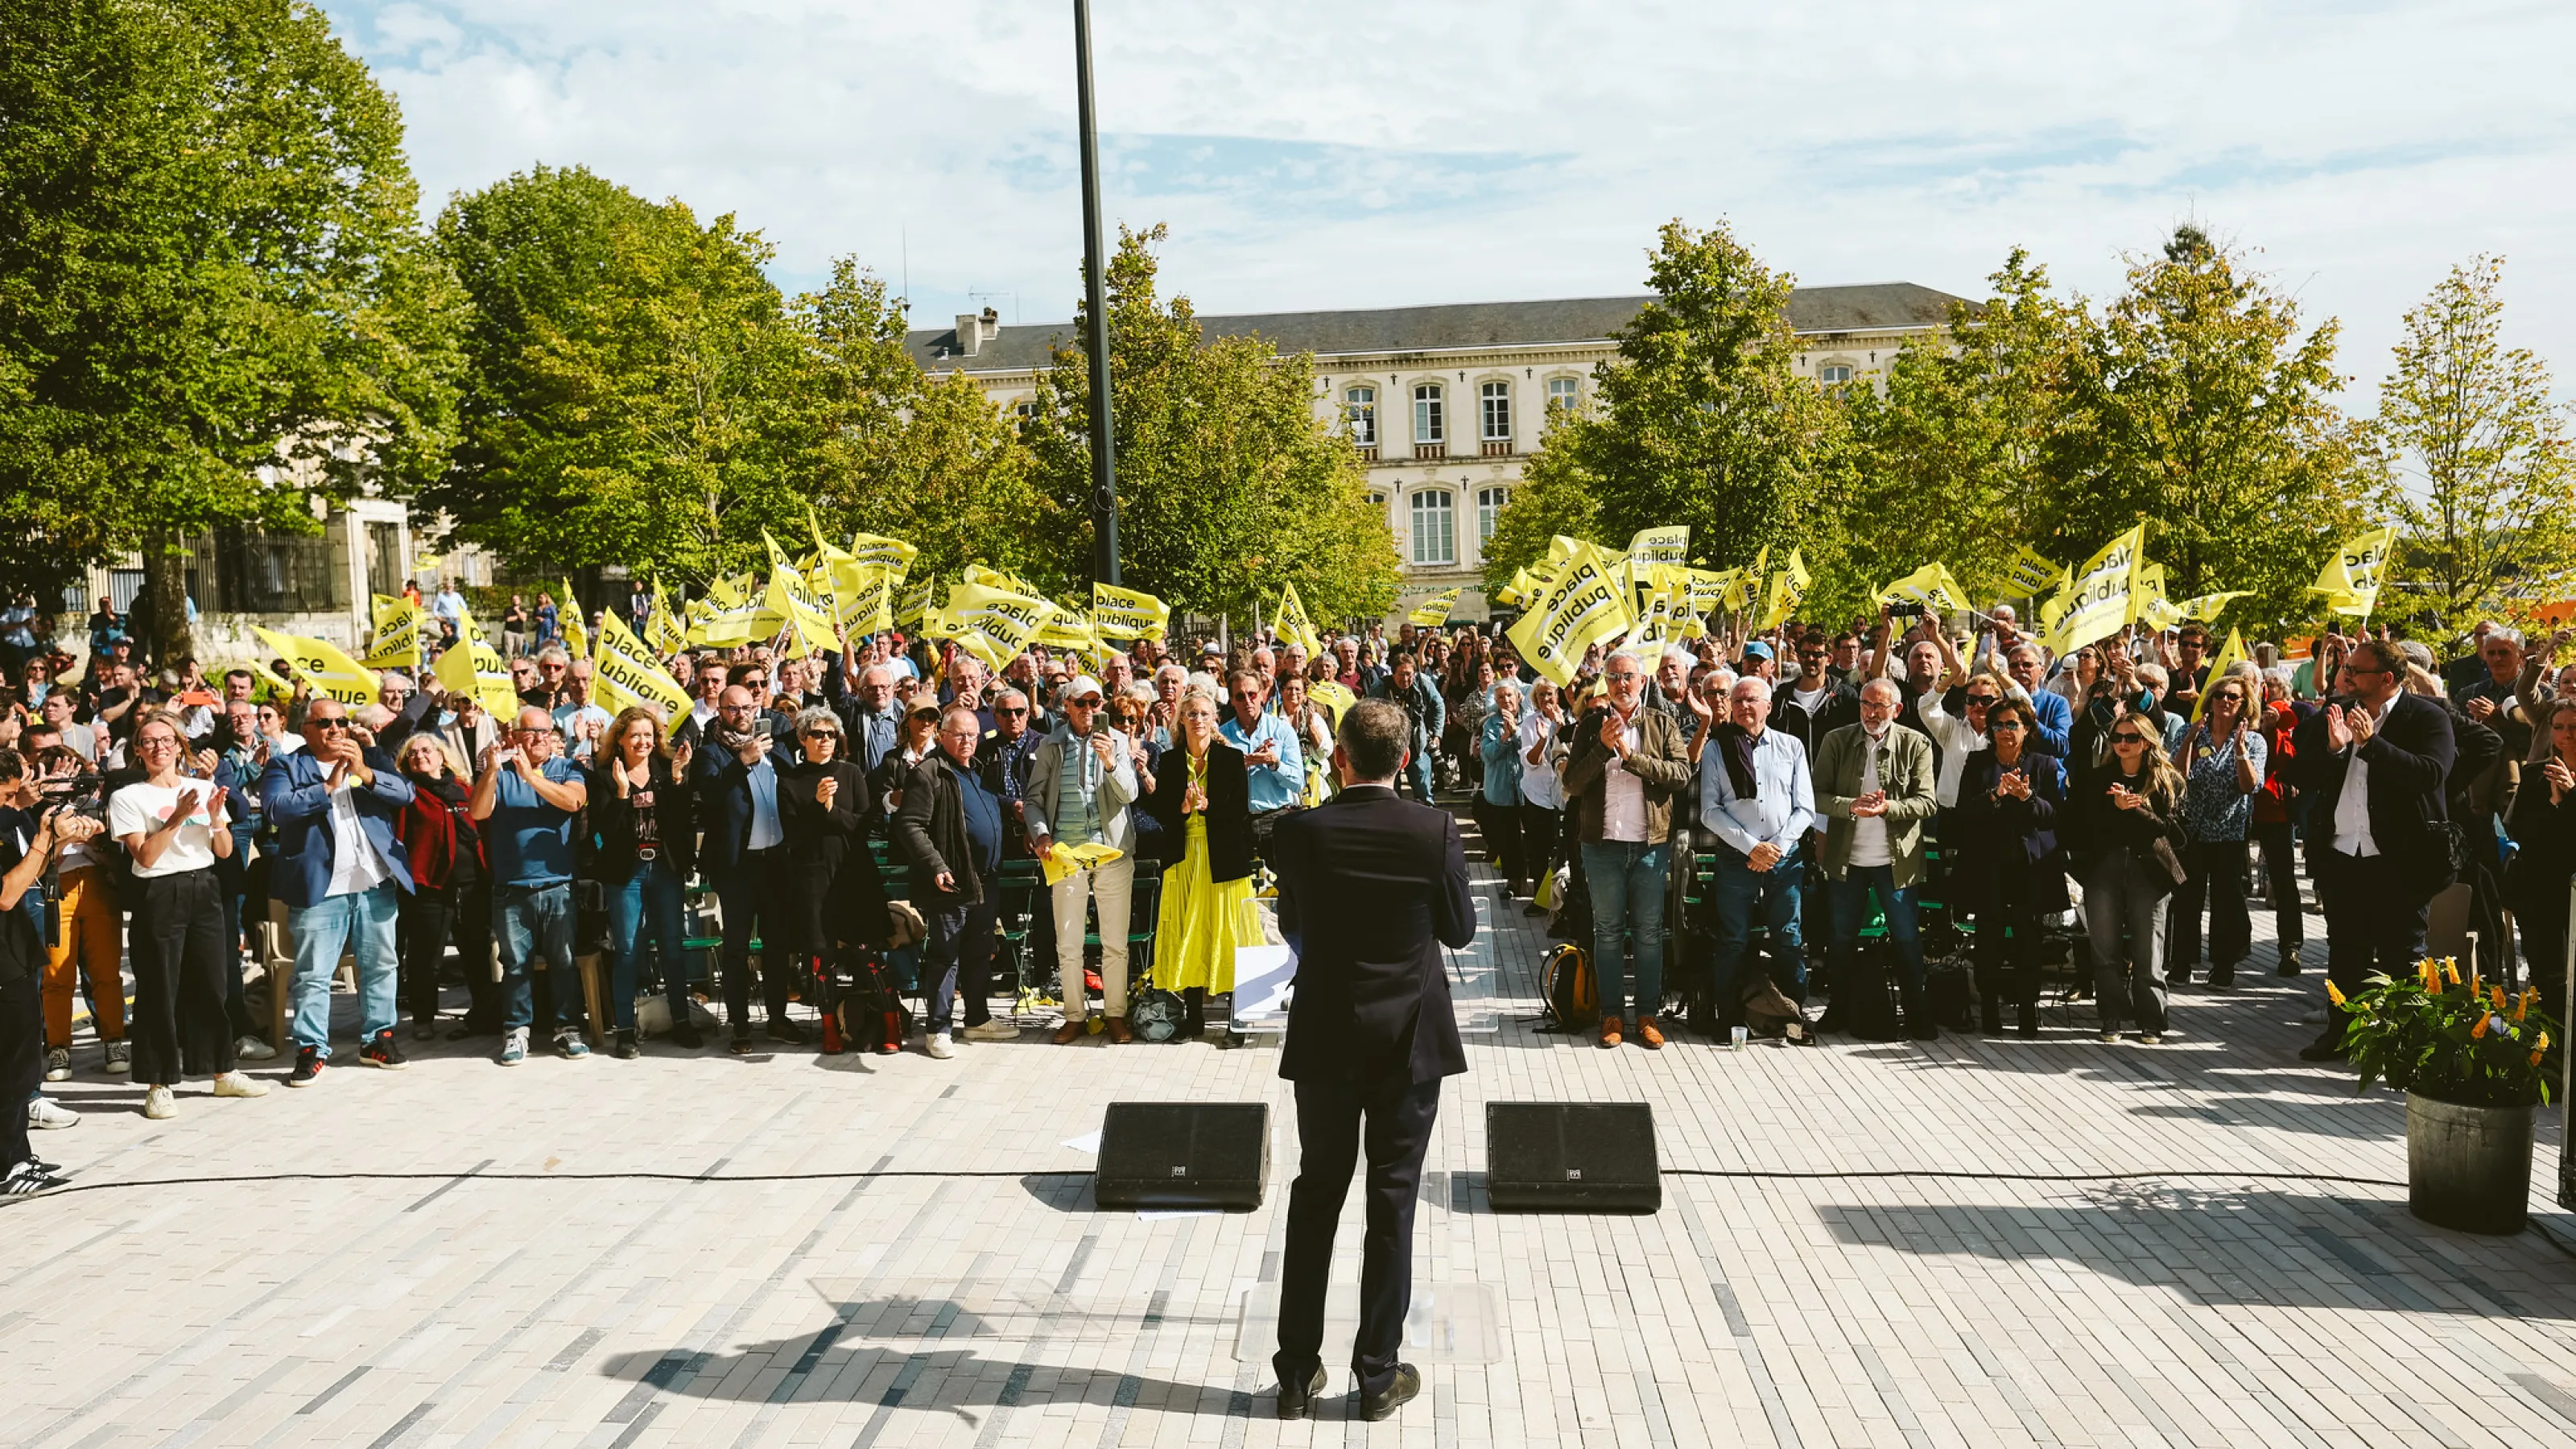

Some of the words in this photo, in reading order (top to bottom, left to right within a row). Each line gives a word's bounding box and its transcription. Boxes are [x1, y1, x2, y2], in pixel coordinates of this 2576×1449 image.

[2019, 557, 2052, 578] place
[1096, 595, 1135, 609] place
[604, 629, 657, 670] place
[600, 660, 679, 713] ublique
